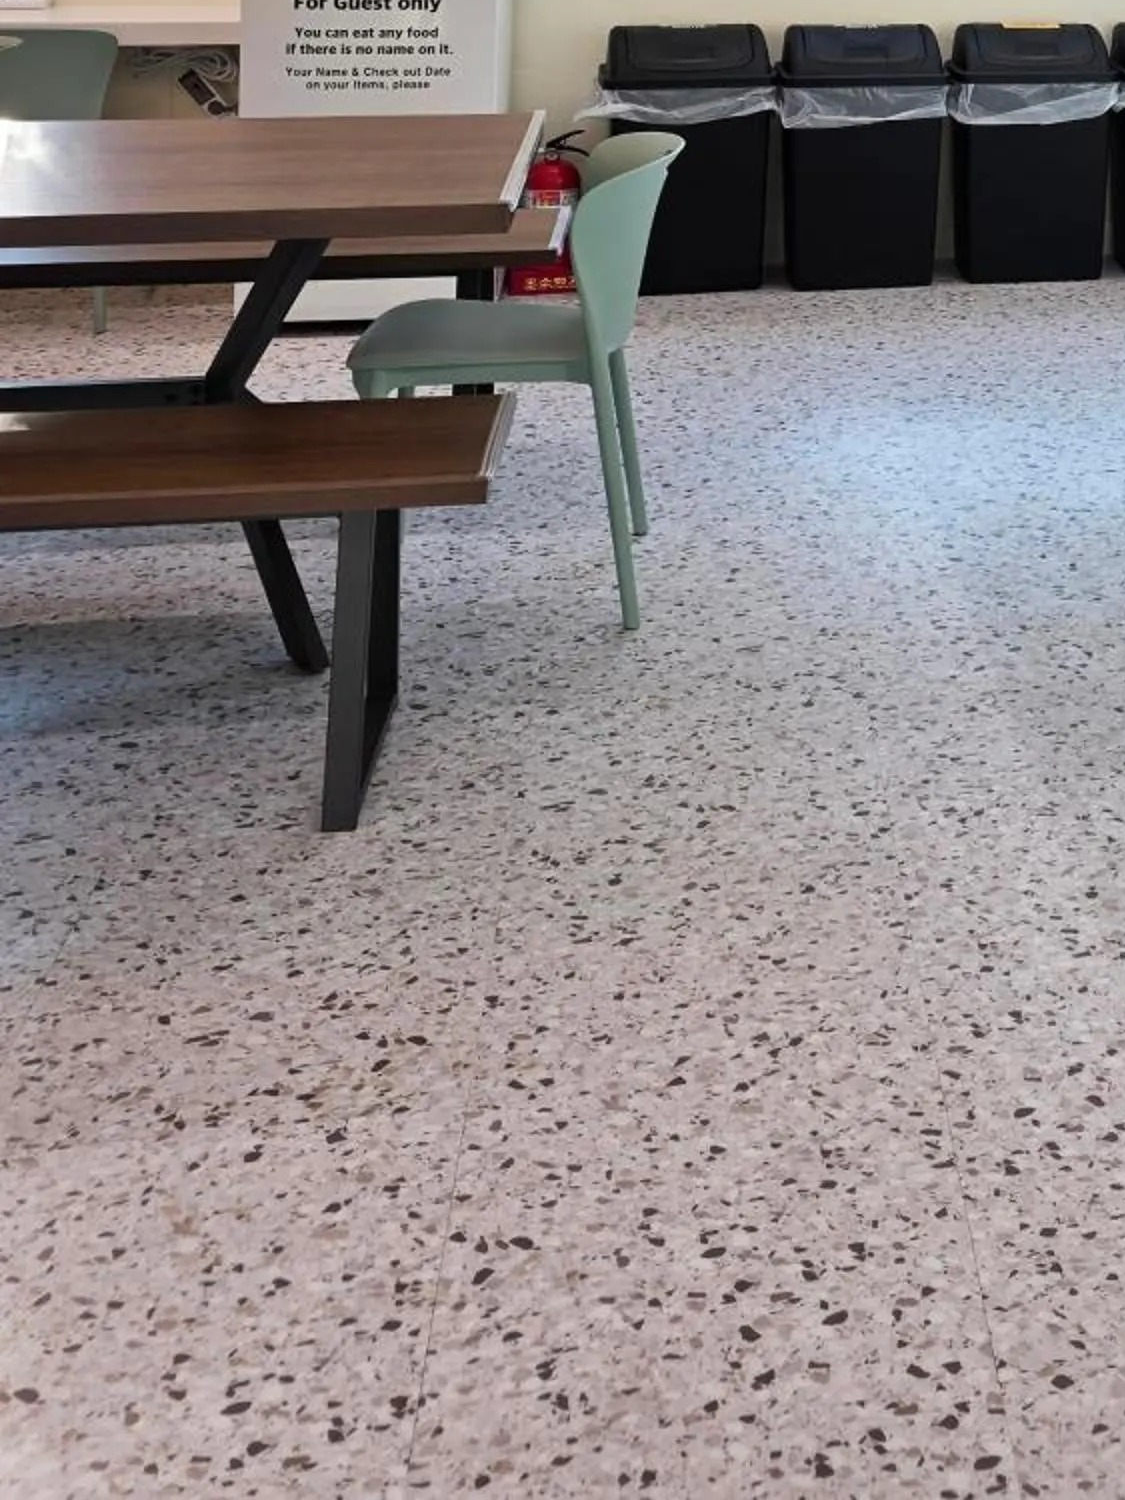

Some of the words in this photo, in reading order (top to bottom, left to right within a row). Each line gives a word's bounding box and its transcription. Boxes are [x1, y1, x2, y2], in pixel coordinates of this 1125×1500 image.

[295, 27, 321, 38] You
[325, 29, 349, 38] can
[352, 28, 375, 38] eat
[378, 29, 403, 40] any
[407, 26, 439, 38] food
[299, 43, 337, 55] there
[341, 43, 352, 55] is
[355, 46, 373, 55] no
[377, 46, 415, 55] name
[418, 46, 436, 55] on
[285, 67, 313, 77] Your
[316, 67, 348, 77] Name
[351, 67, 359, 77] &
[363, 67, 399, 77] Check
[403, 67, 422, 77] out
[425, 67, 451, 77] Date
[306, 81, 321, 89] on
[324, 81, 349, 91] your
[392, 80, 431, 91] please
